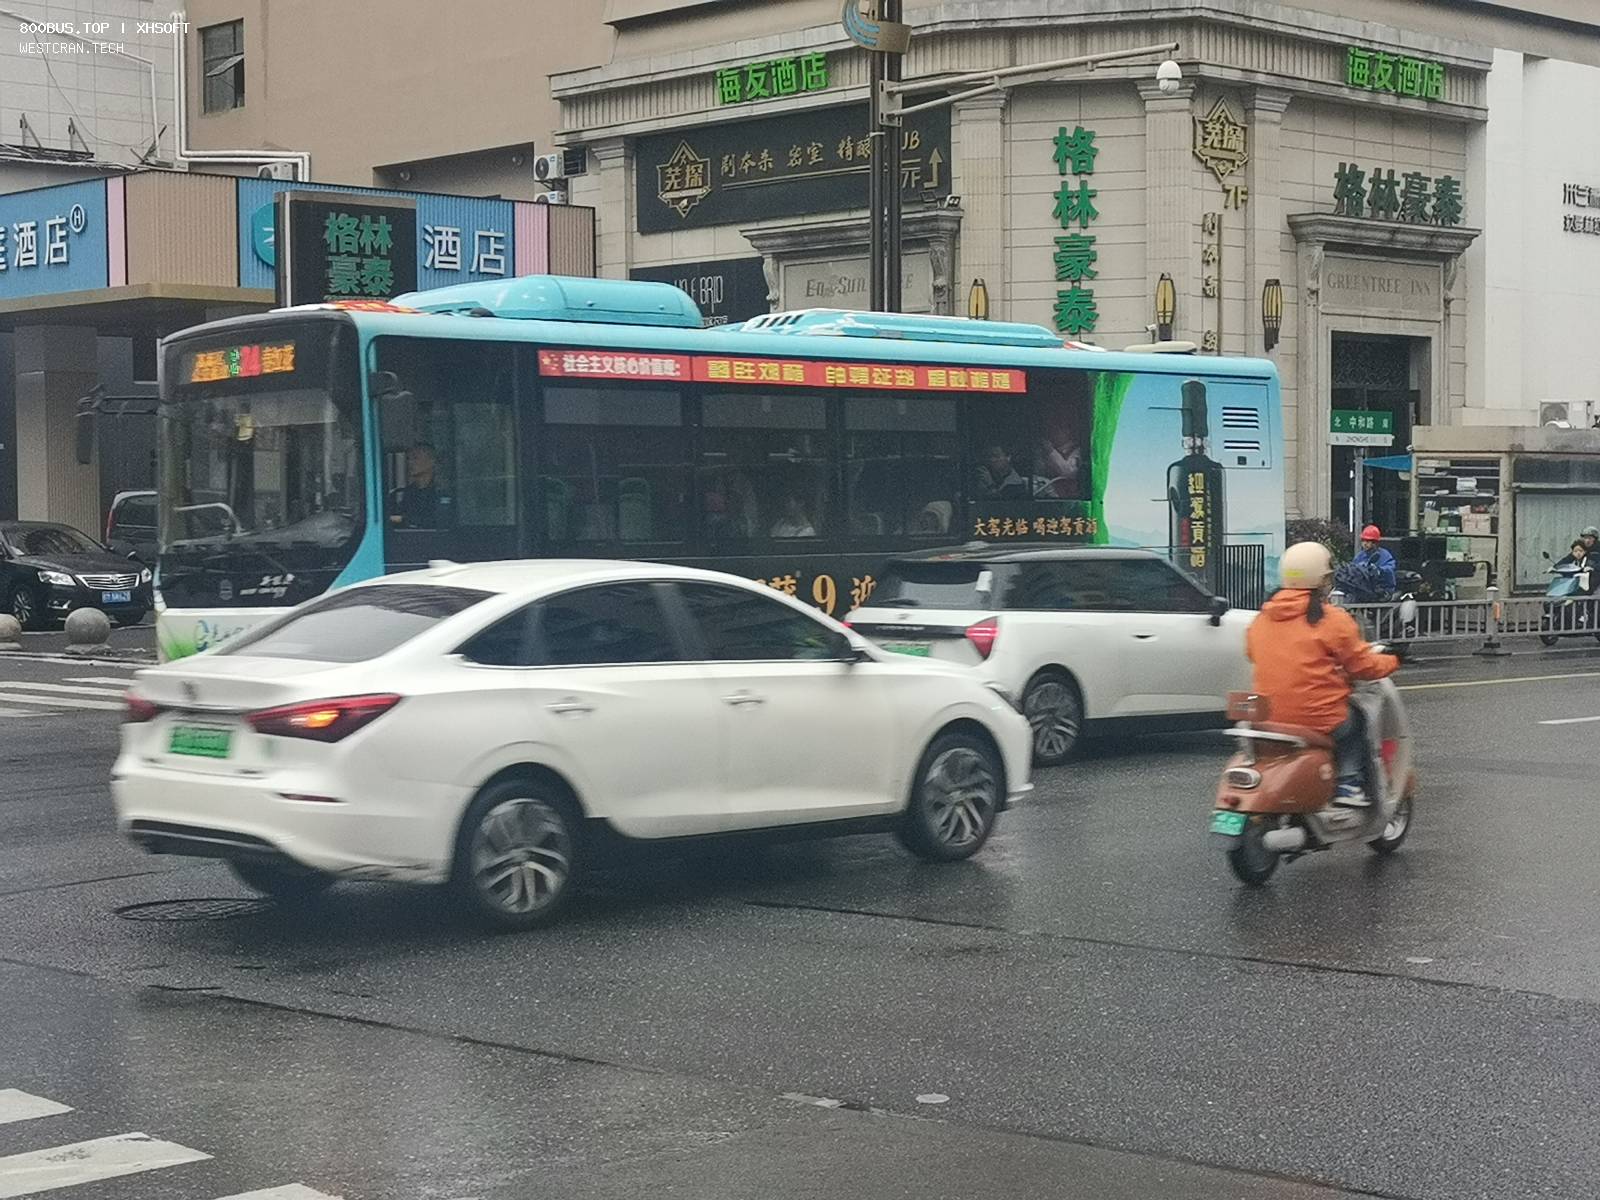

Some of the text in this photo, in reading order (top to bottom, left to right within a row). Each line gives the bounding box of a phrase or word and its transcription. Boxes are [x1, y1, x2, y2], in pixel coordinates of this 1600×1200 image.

[716, 51, 829, 106] 海友酒店
[1347, 46, 1444, 101] 海友酒店
[787, 141, 824, 168] 密室
[1222, 183, 1249, 210] 7F
[1333, 162, 1463, 227] 格林豪泰
[322, 211, 394, 255] 格林
[423, 224, 506, 275] 酒店
[1052, 126, 1100, 335] 格林豪泰
[325, 253, 395, 296] 豪泰
[1327, 272, 1401, 294] GREENTREE
[974, 517, 1029, 537] 大驾光临
[812, 574, 837, 616] 9
